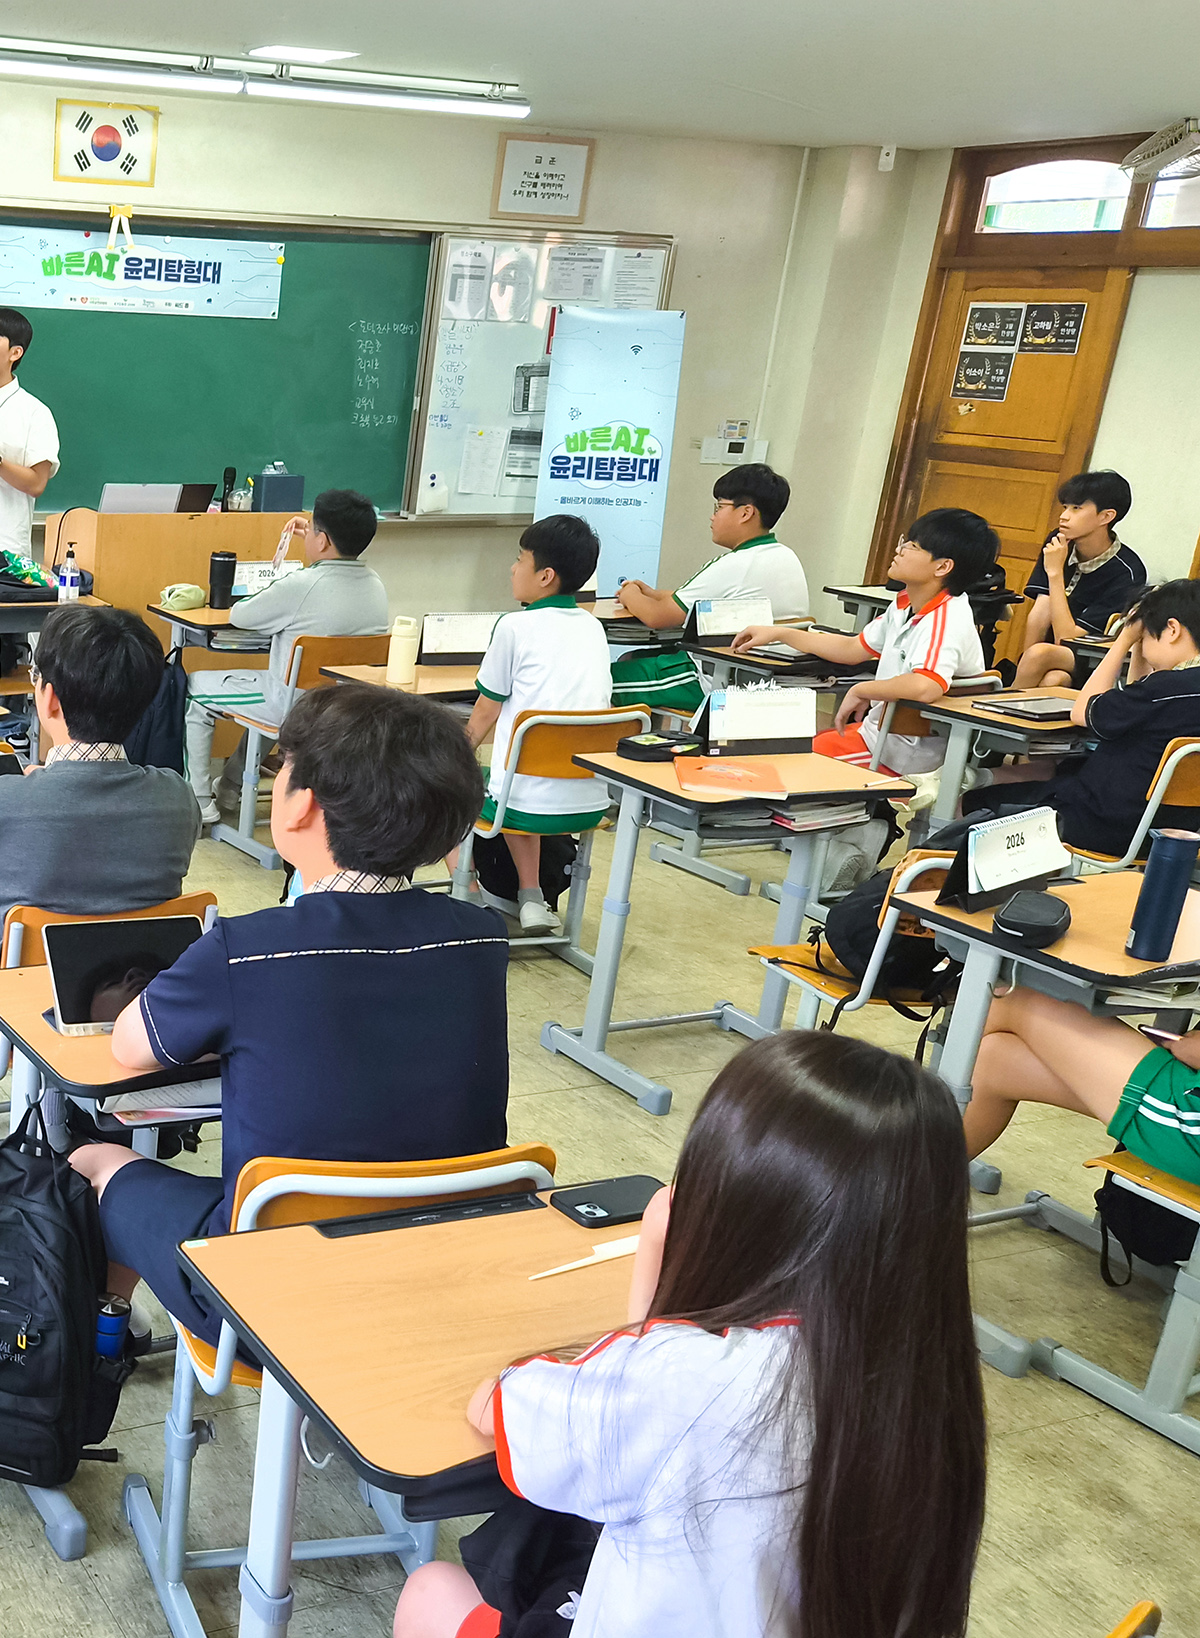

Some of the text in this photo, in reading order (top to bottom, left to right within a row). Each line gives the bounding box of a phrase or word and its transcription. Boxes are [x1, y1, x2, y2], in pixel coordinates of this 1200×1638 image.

[41, 251, 222, 285] 바른AI 윤리탐험대
[564, 426, 651, 456] 바른AI
[549, 455, 660, 482] 윤리탐험대
[258, 569, 276, 578] 2026
[1005, 832, 1026, 850] 2026
